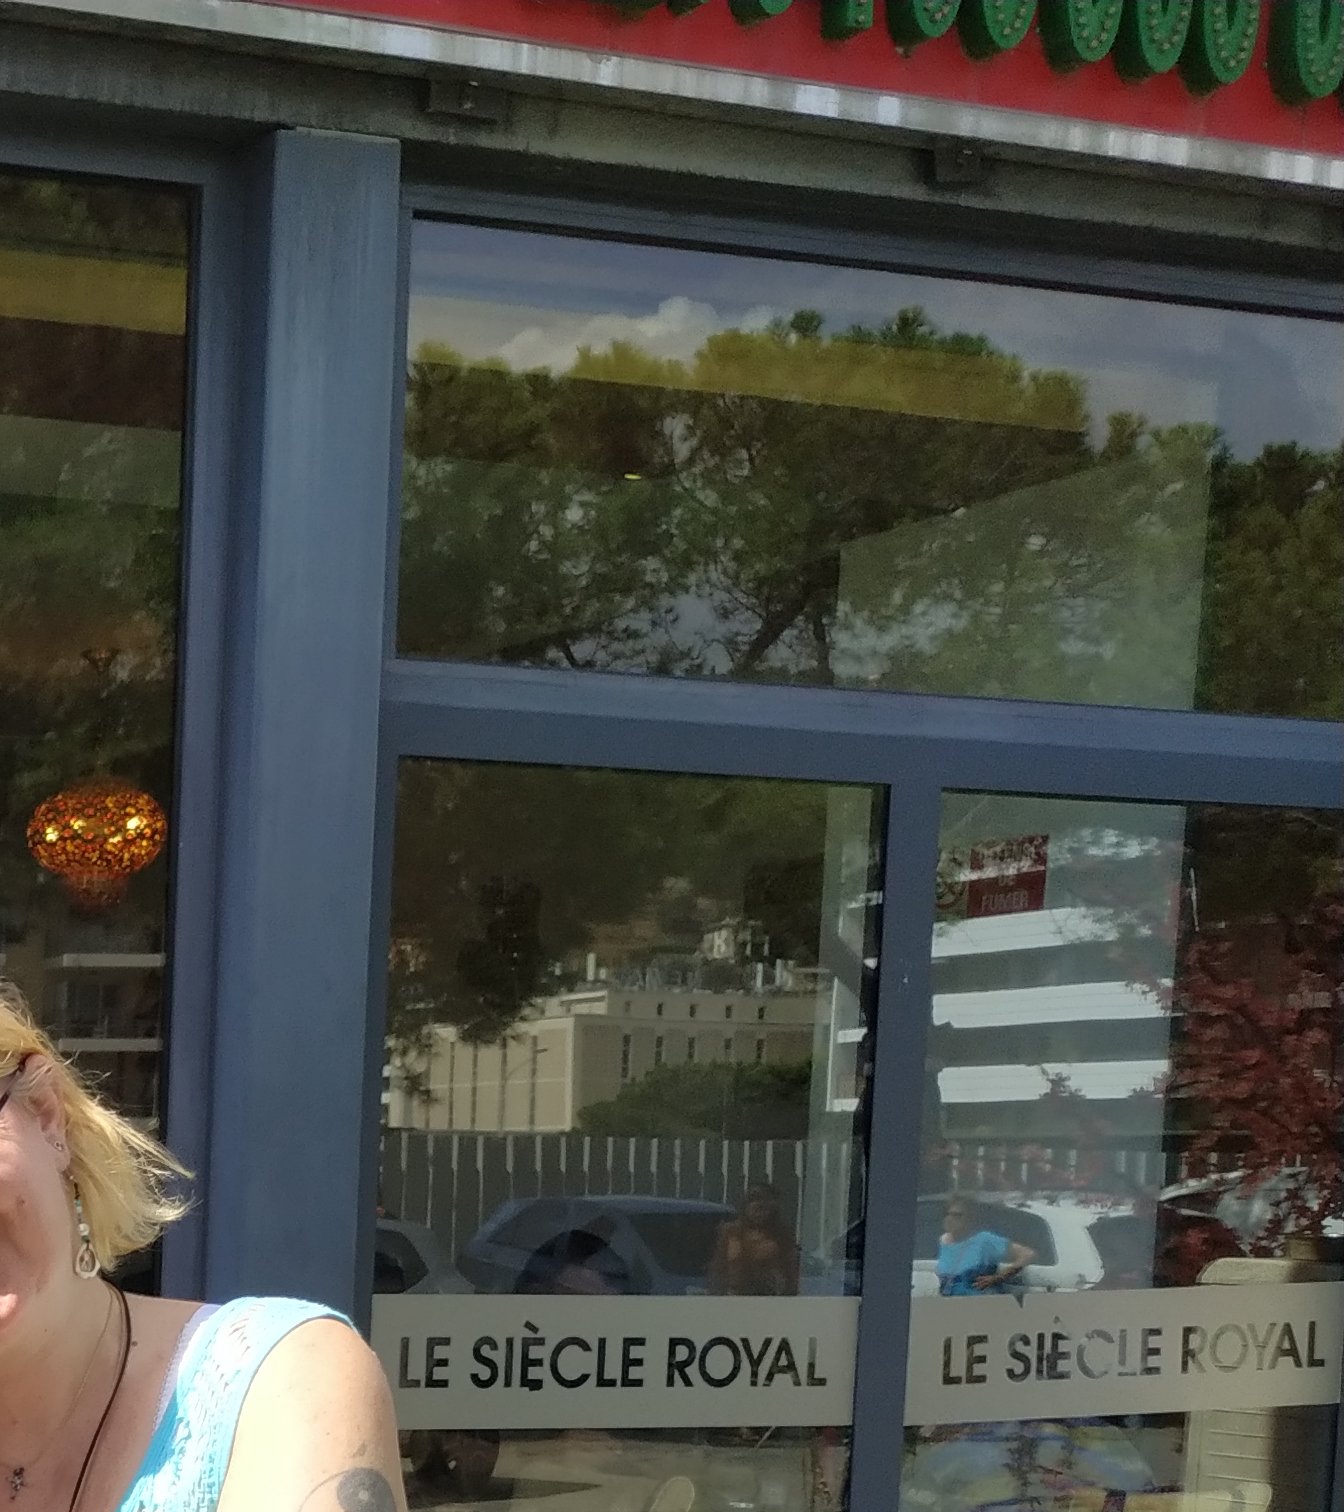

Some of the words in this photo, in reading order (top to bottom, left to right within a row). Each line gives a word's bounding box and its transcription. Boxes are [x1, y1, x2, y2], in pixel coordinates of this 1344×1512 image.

[398, 1336, 452, 1389] LE
[469, 1319, 647, 1391] SIÈCLE
[665, 1335, 828, 1389] ROYAL
[941, 1334, 990, 1386] LE
[1180, 1320, 1326, 1375] ROYAL
